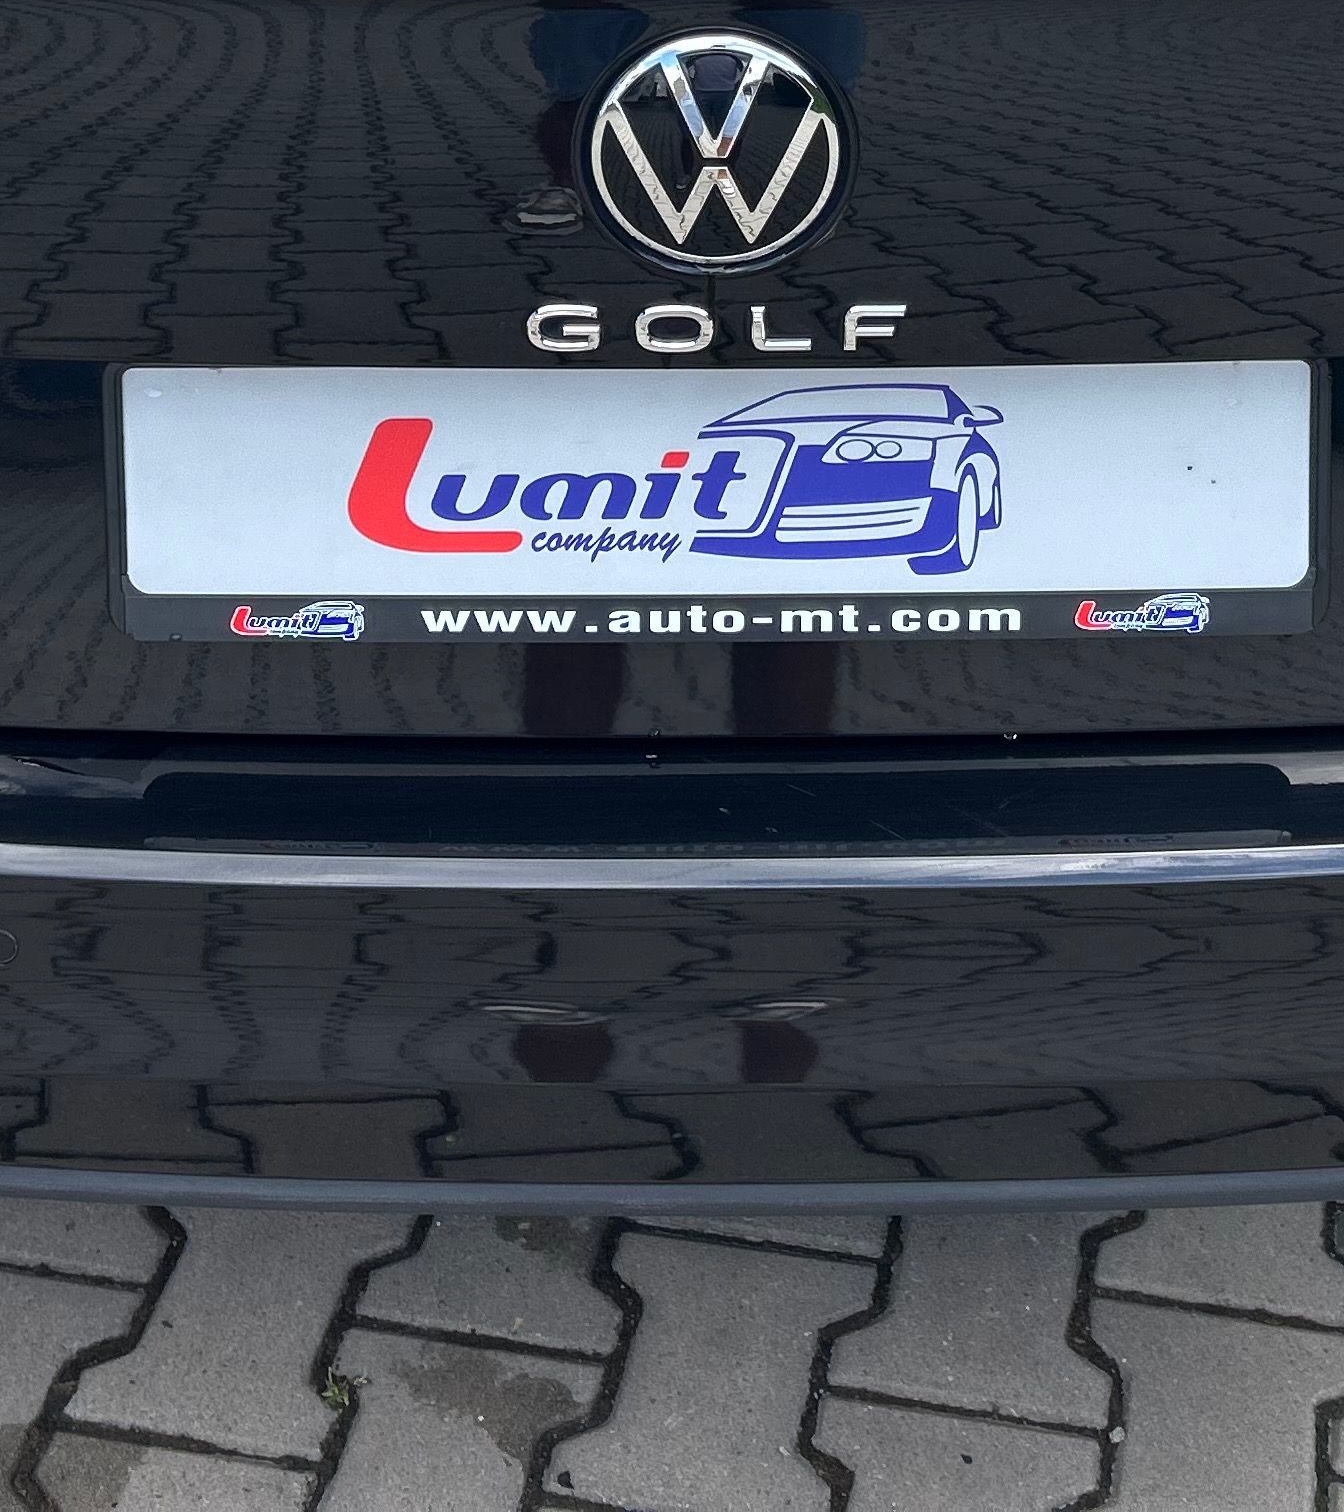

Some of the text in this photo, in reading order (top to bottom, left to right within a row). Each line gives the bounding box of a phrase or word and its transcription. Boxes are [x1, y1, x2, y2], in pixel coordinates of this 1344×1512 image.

[526, 303, 908, 352] GOLF
[347, 417, 747, 553] Lumit
[531, 526, 683, 562] company
[231, 606, 315, 636] Lumit
[420, 604, 1023, 634] www.auto-mt.com
[1074, 600, 1162, 630] Lumit
